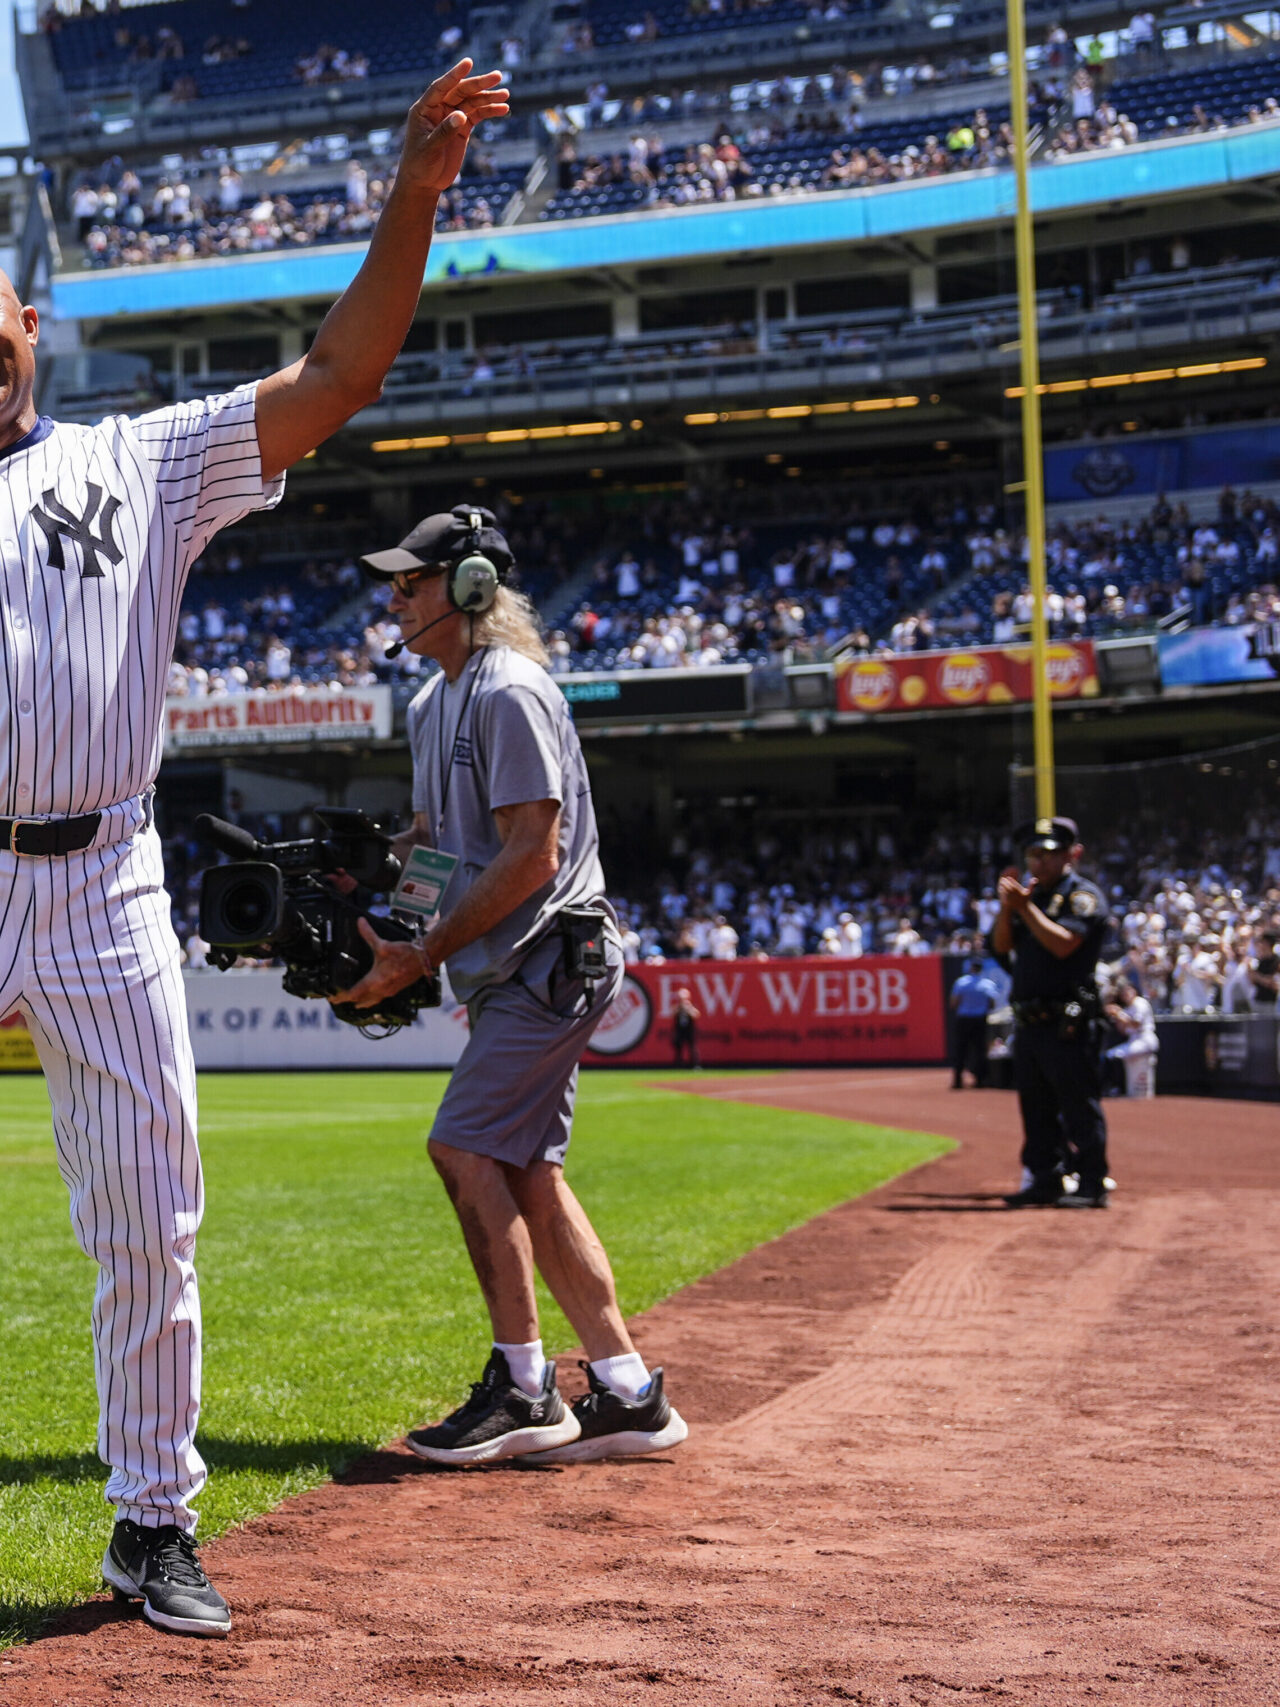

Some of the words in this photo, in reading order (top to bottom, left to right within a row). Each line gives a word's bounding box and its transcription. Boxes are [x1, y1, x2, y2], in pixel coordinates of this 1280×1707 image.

[31, 481, 125, 578] NY
[1045, 657, 1080, 684] ay's
[168, 702, 238, 730] Parts
[246, 696, 376, 728] Authority
[760, 969, 910, 1016] WEBB
[223, 1007, 261, 1030] OF
